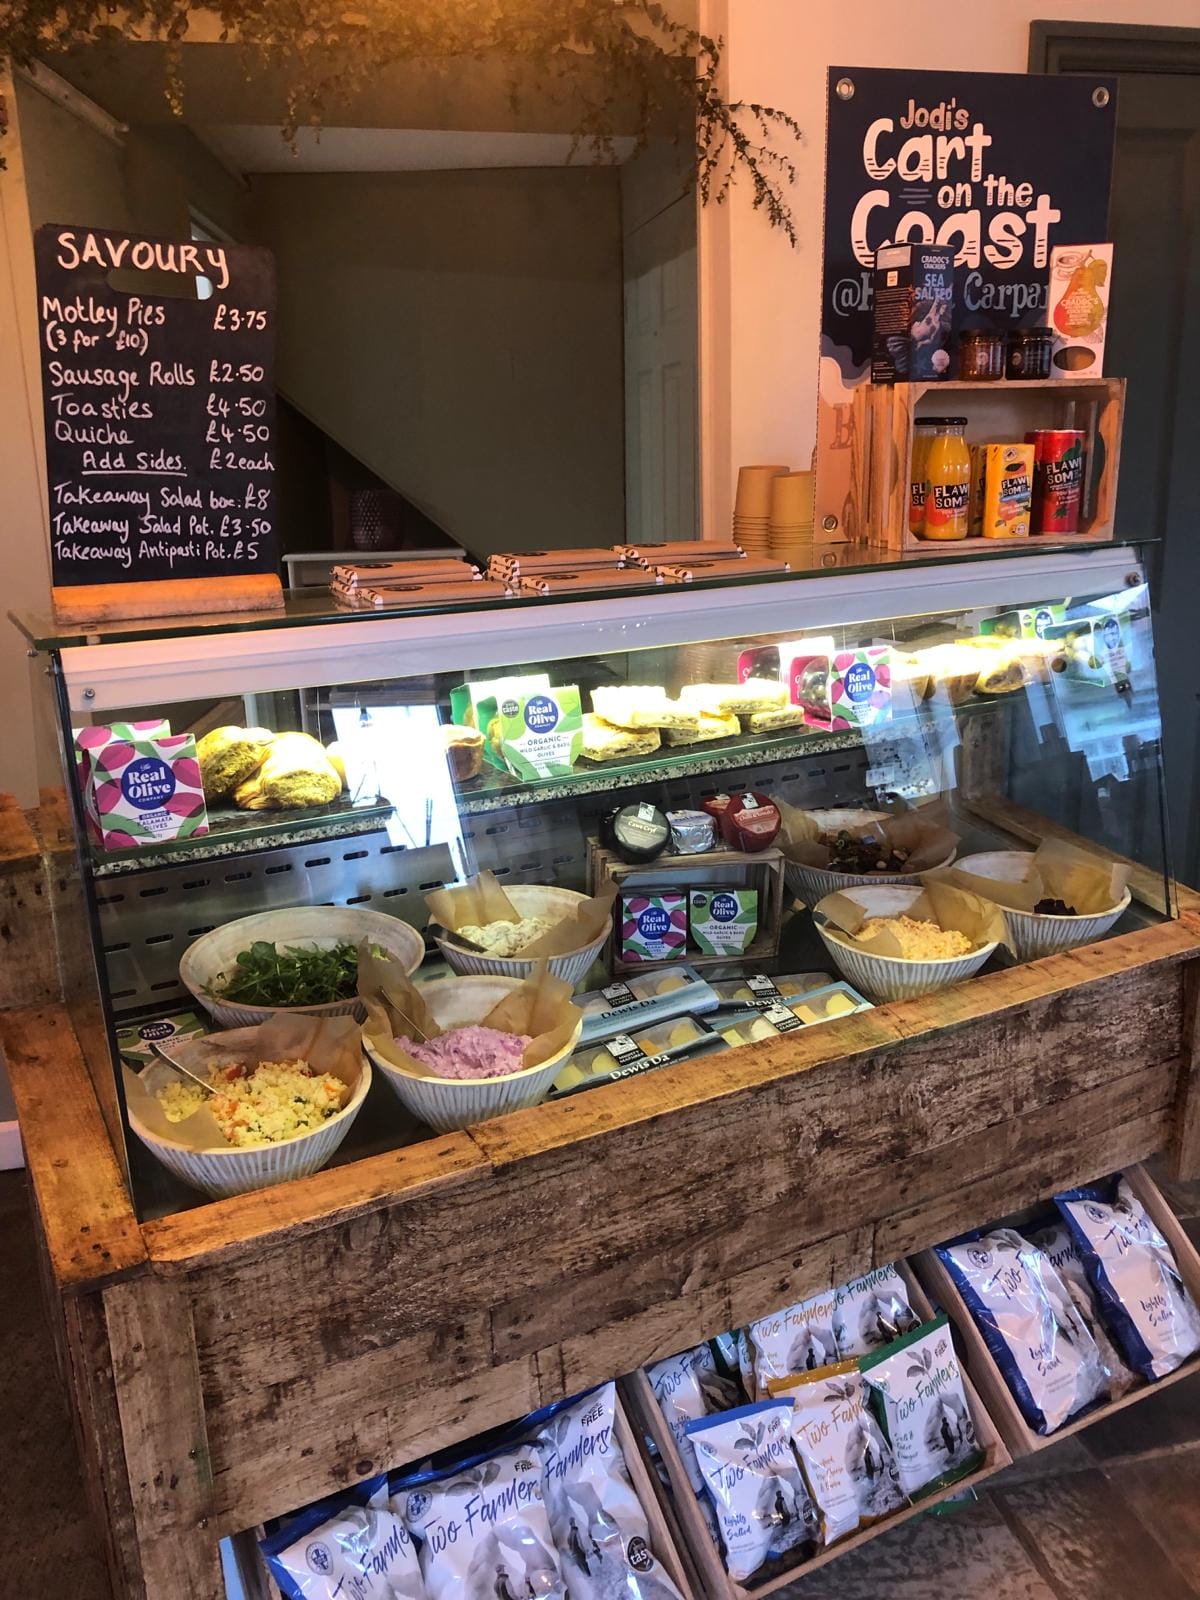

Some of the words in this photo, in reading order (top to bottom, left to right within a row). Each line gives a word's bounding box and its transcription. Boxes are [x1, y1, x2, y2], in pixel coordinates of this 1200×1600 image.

[900, 97, 970, 132] Jodi's
[863, 117, 993, 183] Cart
[937, 182, 972, 209] on
[983, 174, 1033, 208] the
[850, 189, 1061, 270] Coast
[925, 273, 944, 287] SEA
[42, 296, 118, 338] Motley
[127, 297, 165, 326] Pies
[72, 329, 100, 354] for
[49, 361, 140, 403] Sausage
[149, 361, 196, 387] Rolls
[51, 393, 153, 420] Toasties
[54, 420, 135, 445] Quiche
[82, 450, 126, 470] Add
[53, 481, 150, 520] Takeaway
[160, 486, 203, 509] Salad
[244, 483, 271, 510] £8
[912, 484, 925, 495] FL
[52, 512, 130, 544] Takeaway
[139, 515, 181, 536] Salad
[54, 540, 132, 569] Takeaway
[138, 543, 201, 569] Antipasti
[233, 542, 260, 561] £5
[848, 682, 873, 694] Olive
[849, 672, 871, 683] Real
[528, 703, 552, 715] Real
[528, 714, 556, 726] Olive
[527, 735, 561, 747] ORGANIC
[128, 766, 166, 785] Real
[128, 782, 171, 799] Olive
[712, 908, 735, 916] Olive
[714, 900, 734, 908] Real
[641, 923, 667, 932] Olive
[643, 914, 665, 923] Real
[601, 1005, 639, 1020] Dewis
[609, 1061, 650, 1080] Dewis
[650, 1054, 670, 1065] Da
[654, 1370, 682, 1401] Two
[581, 1405, 604, 1427] FREE
[796, 1420, 830, 1449] Two
[545, 1426, 610, 1490] Farmers
[710, 1462, 745, 1489] Two
[423, 1516, 463, 1563] Two
[360, 1525, 410, 1589] Farme
[629, 1549, 648, 1565] tas
